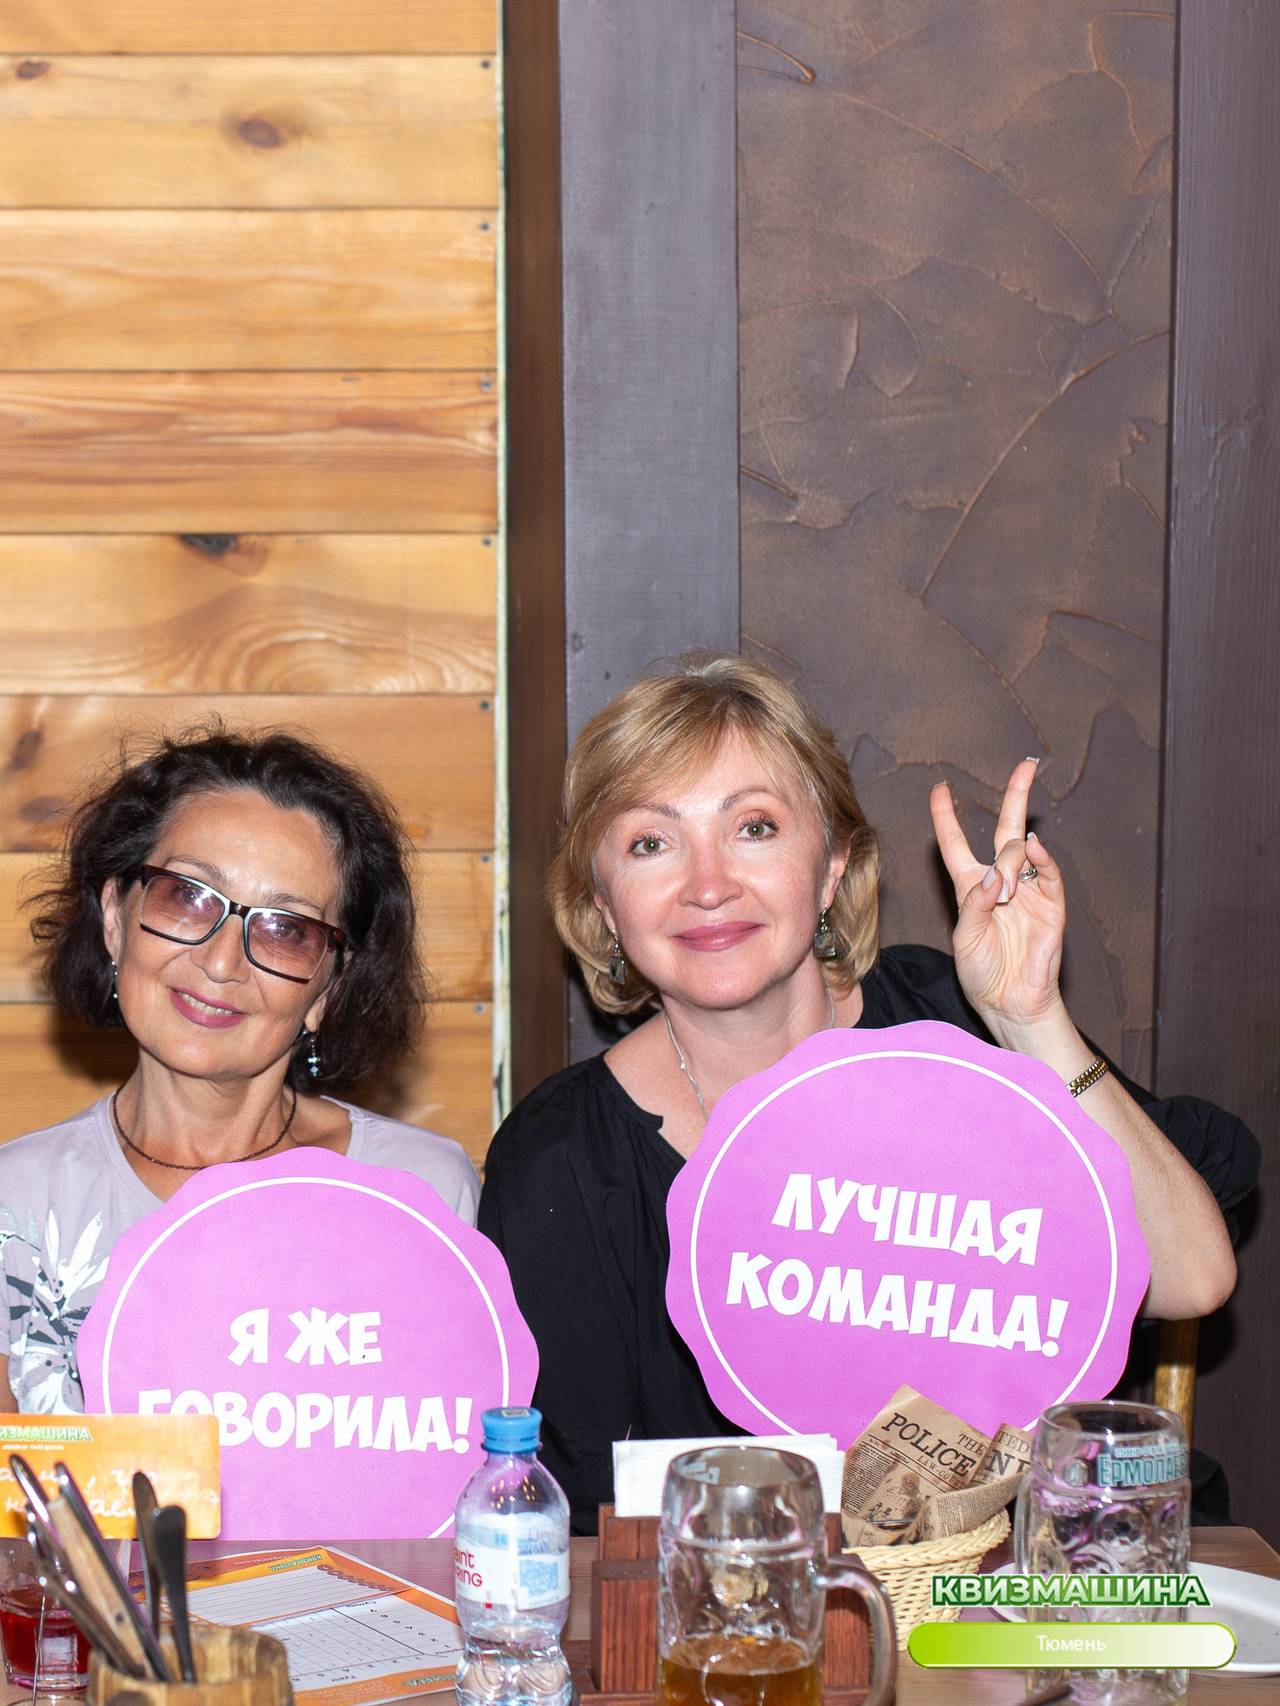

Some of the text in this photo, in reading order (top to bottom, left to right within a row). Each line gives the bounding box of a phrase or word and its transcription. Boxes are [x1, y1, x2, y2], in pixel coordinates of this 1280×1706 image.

[771, 1173, 1043, 1266] ЛУЧШАЯ
[725, 1251, 1069, 1357] КОМАНДА!
[227, 1307, 382, 1367] Я ЖЕ
[881, 1412, 977, 1478] POLICE
[957, 1433, 988, 1456] THE
[1098, 1453, 1187, 1487] ЕРМОЛАЕВ
[268, 1554, 323, 1571] КВИЗМАШИНА
[454, 1547, 476, 1569] aint
